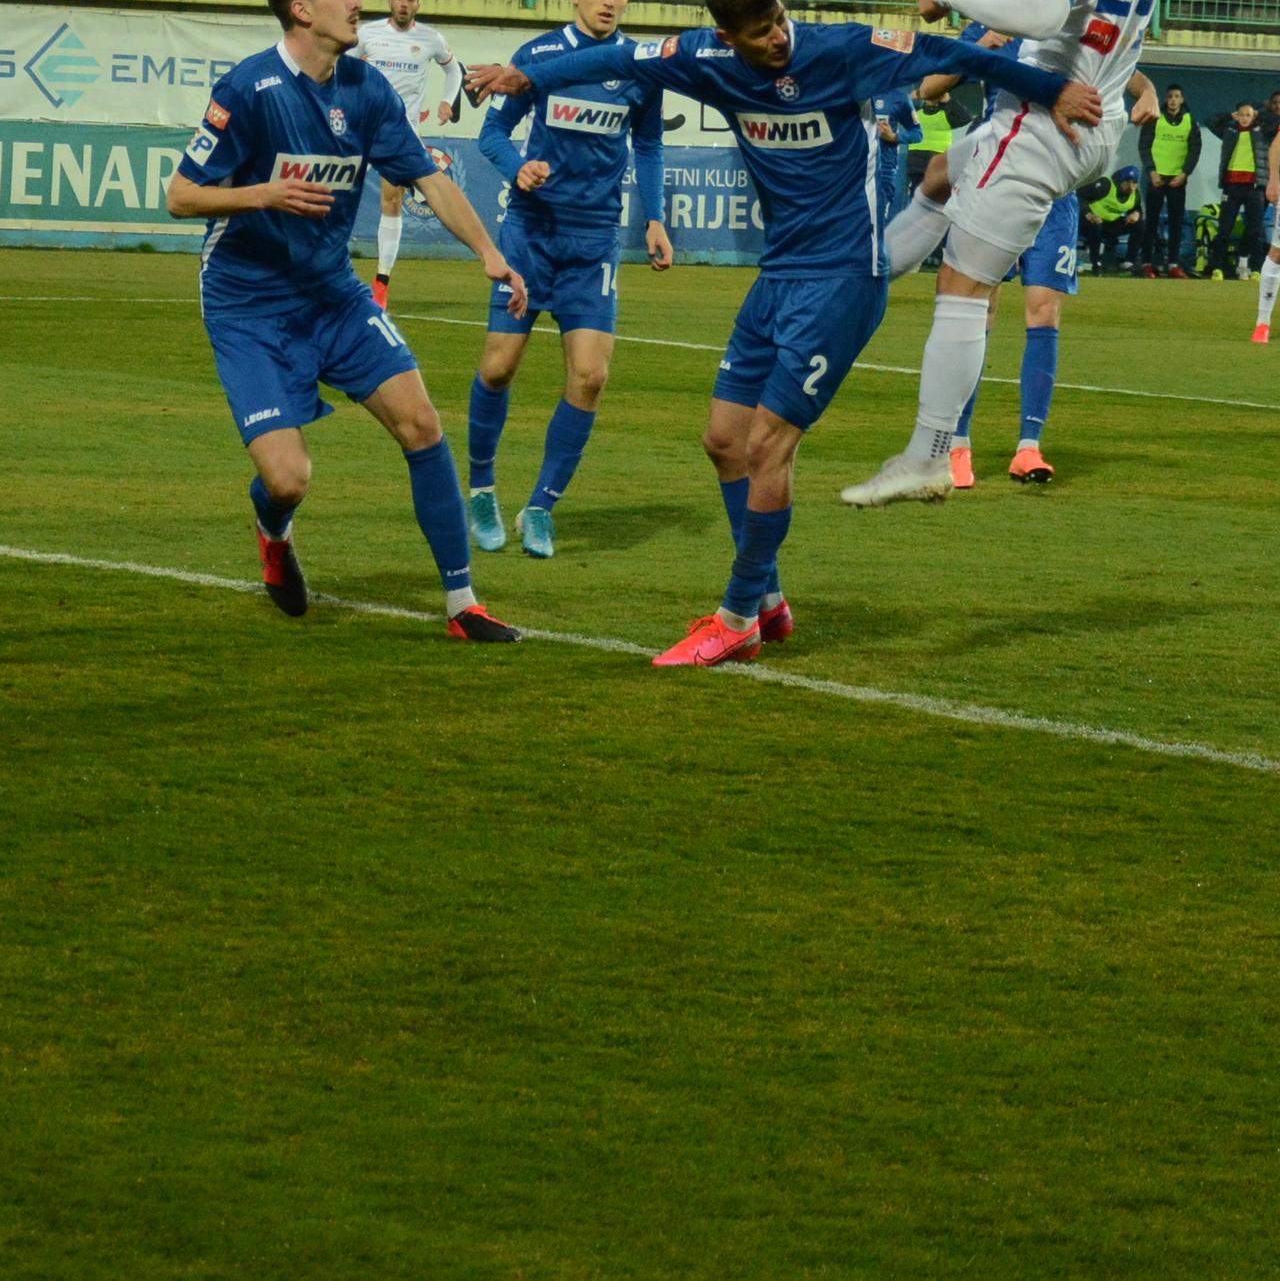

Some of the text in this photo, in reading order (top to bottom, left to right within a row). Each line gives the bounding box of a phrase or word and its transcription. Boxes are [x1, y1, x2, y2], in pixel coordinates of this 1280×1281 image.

[695, 46, 736, 58] LEGEA
[704, 169, 748, 188] KLUB
[802, 354, 828, 396] 2
[244, 407, 281, 427] LEGEA
